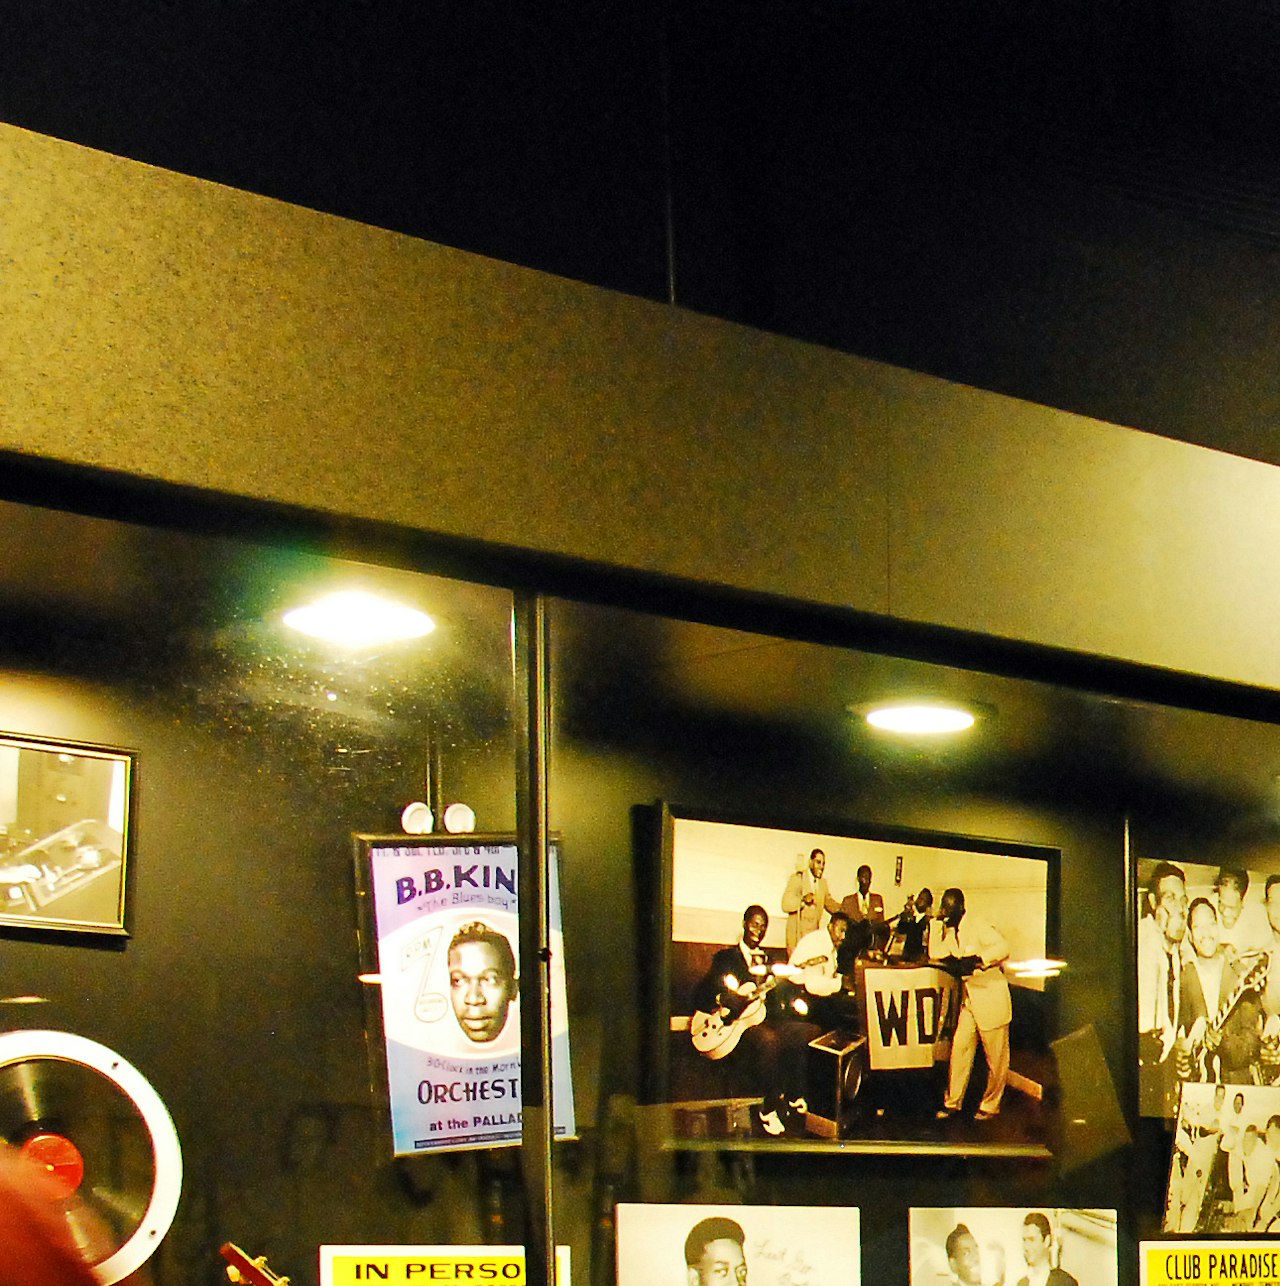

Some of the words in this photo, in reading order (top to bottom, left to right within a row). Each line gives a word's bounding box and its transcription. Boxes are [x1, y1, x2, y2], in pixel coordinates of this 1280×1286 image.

[452, 893, 484, 905] Blues
[874, 988, 941, 1047] WD
[417, 1078, 519, 1104] ORCHEST
[429, 1120, 443, 1131] at
[447, 1118, 469, 1130] the
[472, 1113, 522, 1127] PALLAD
[355, 1263, 389, 1279] IN
[406, 1263, 521, 1279] PERSO
[1166, 1254, 1200, 1280] CLUB
[1209, 1253, 1278, 1279] PARADISE
